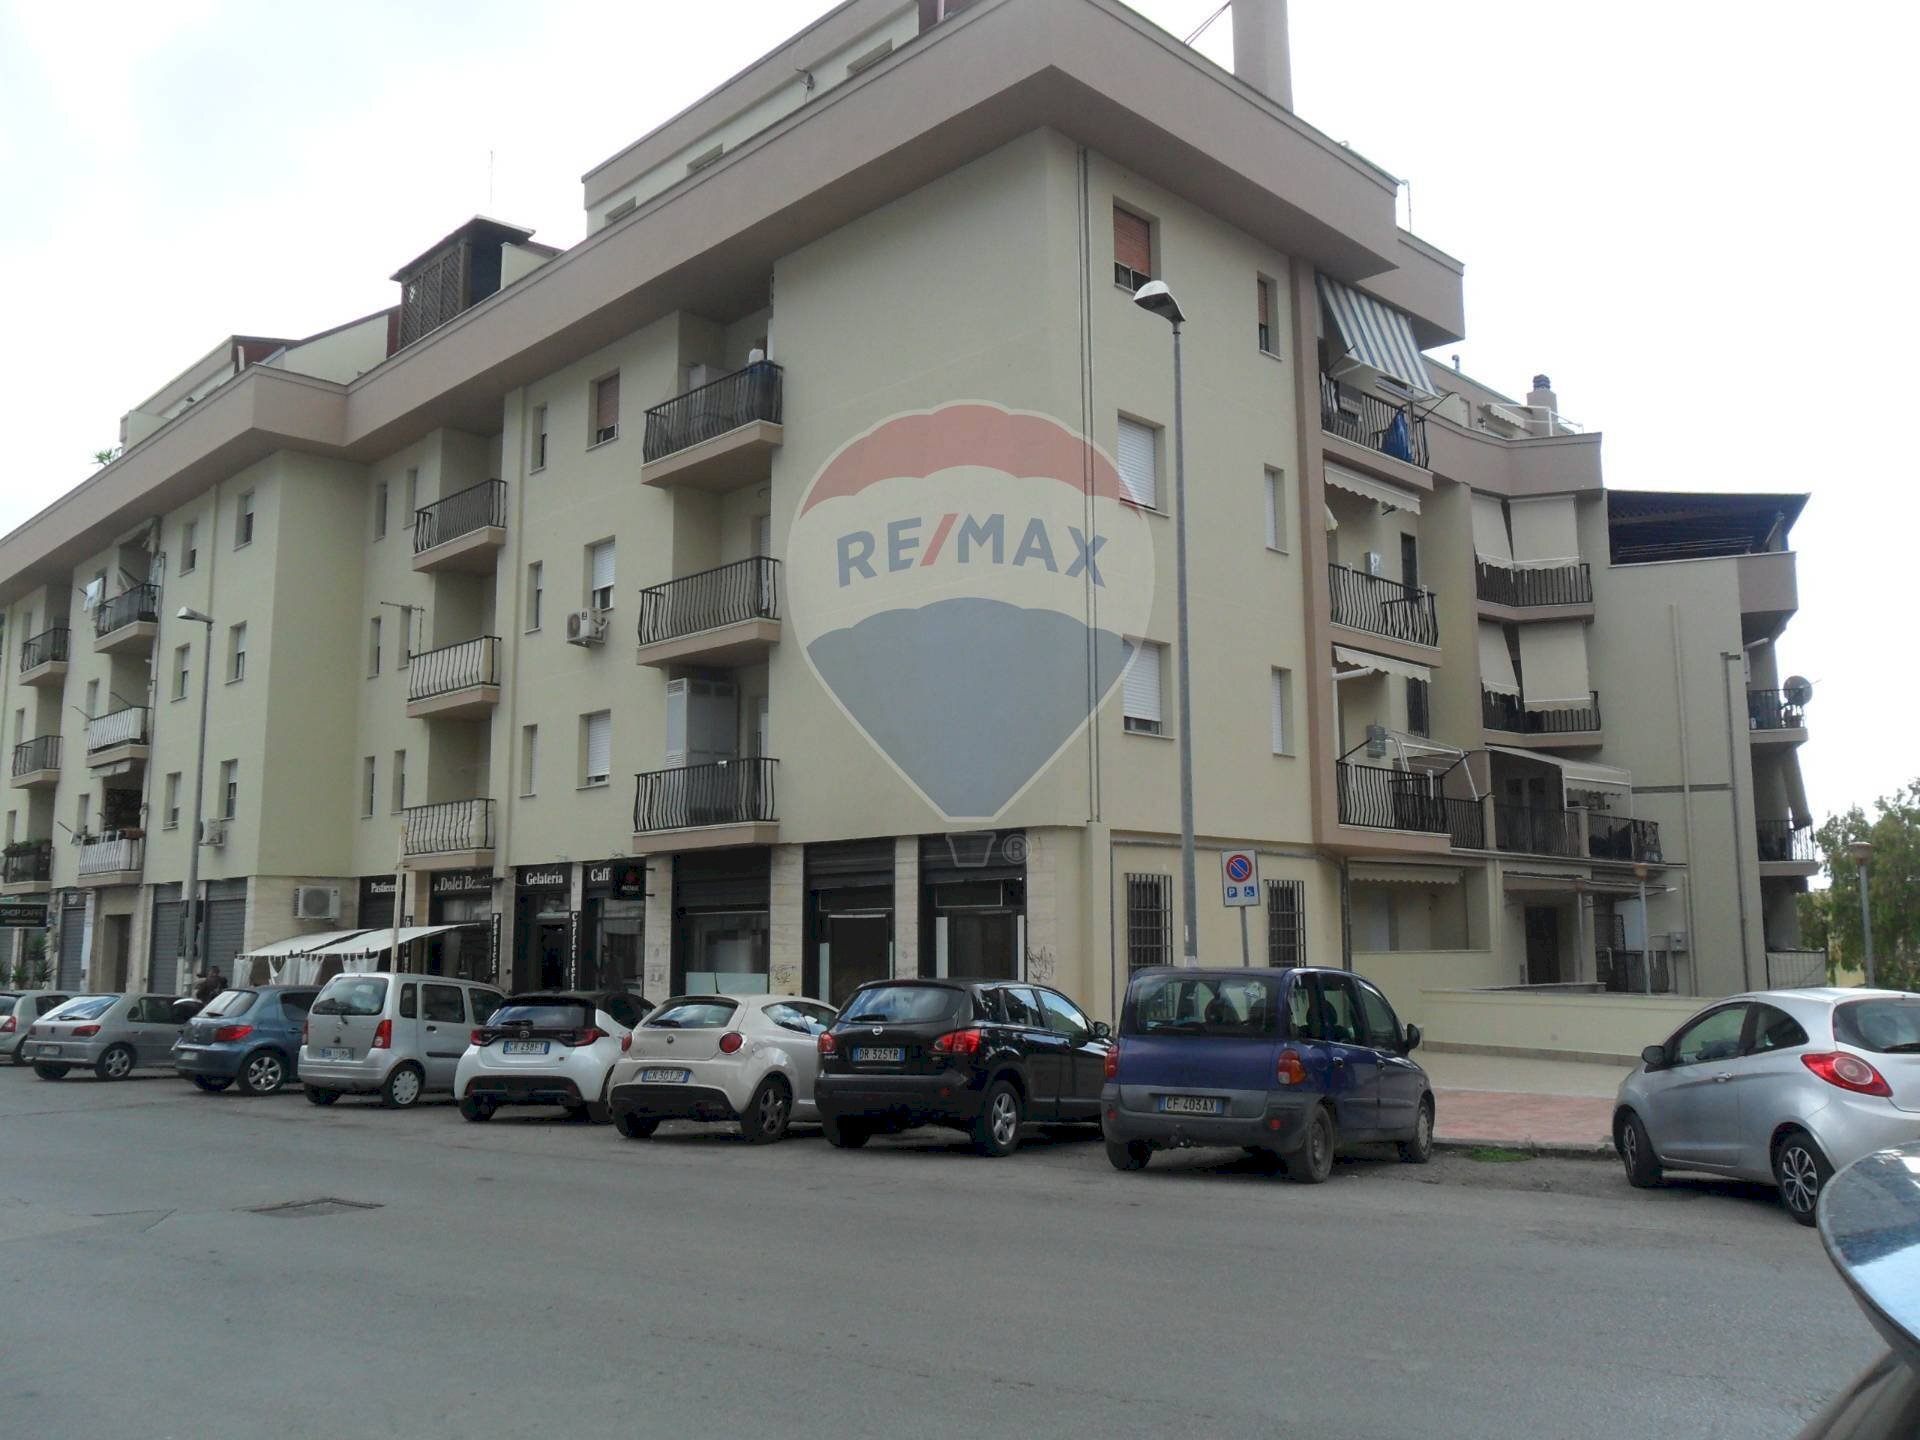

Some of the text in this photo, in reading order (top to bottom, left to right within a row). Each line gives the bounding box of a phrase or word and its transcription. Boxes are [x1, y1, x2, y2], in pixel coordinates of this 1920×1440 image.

[526, 872, 563, 885] Gelateria
[591, 867, 612, 882] Caff
[440, 876, 463, 891] Dolci
[859, 1048, 869, 1060] DR
[1166, 1096, 1216, 1112] CF 403AX
